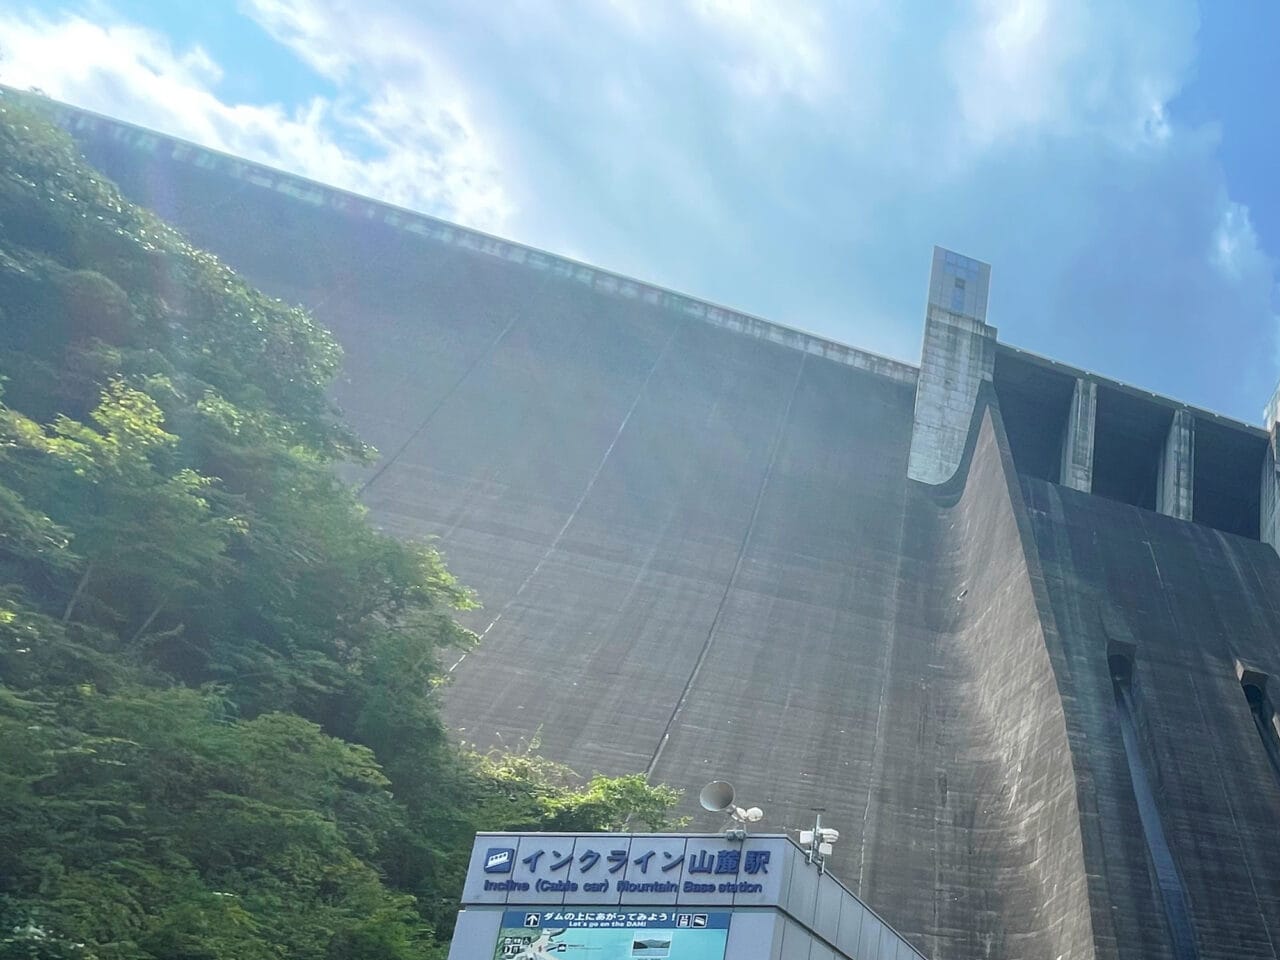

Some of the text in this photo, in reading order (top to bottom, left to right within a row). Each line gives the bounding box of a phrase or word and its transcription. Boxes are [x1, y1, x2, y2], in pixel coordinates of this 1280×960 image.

[522, 848, 772, 875] インクライン山麓駅
[484, 879, 530, 892] Incline
[617, 880, 679, 893] Mountain
[683, 881, 716, 893] Base
